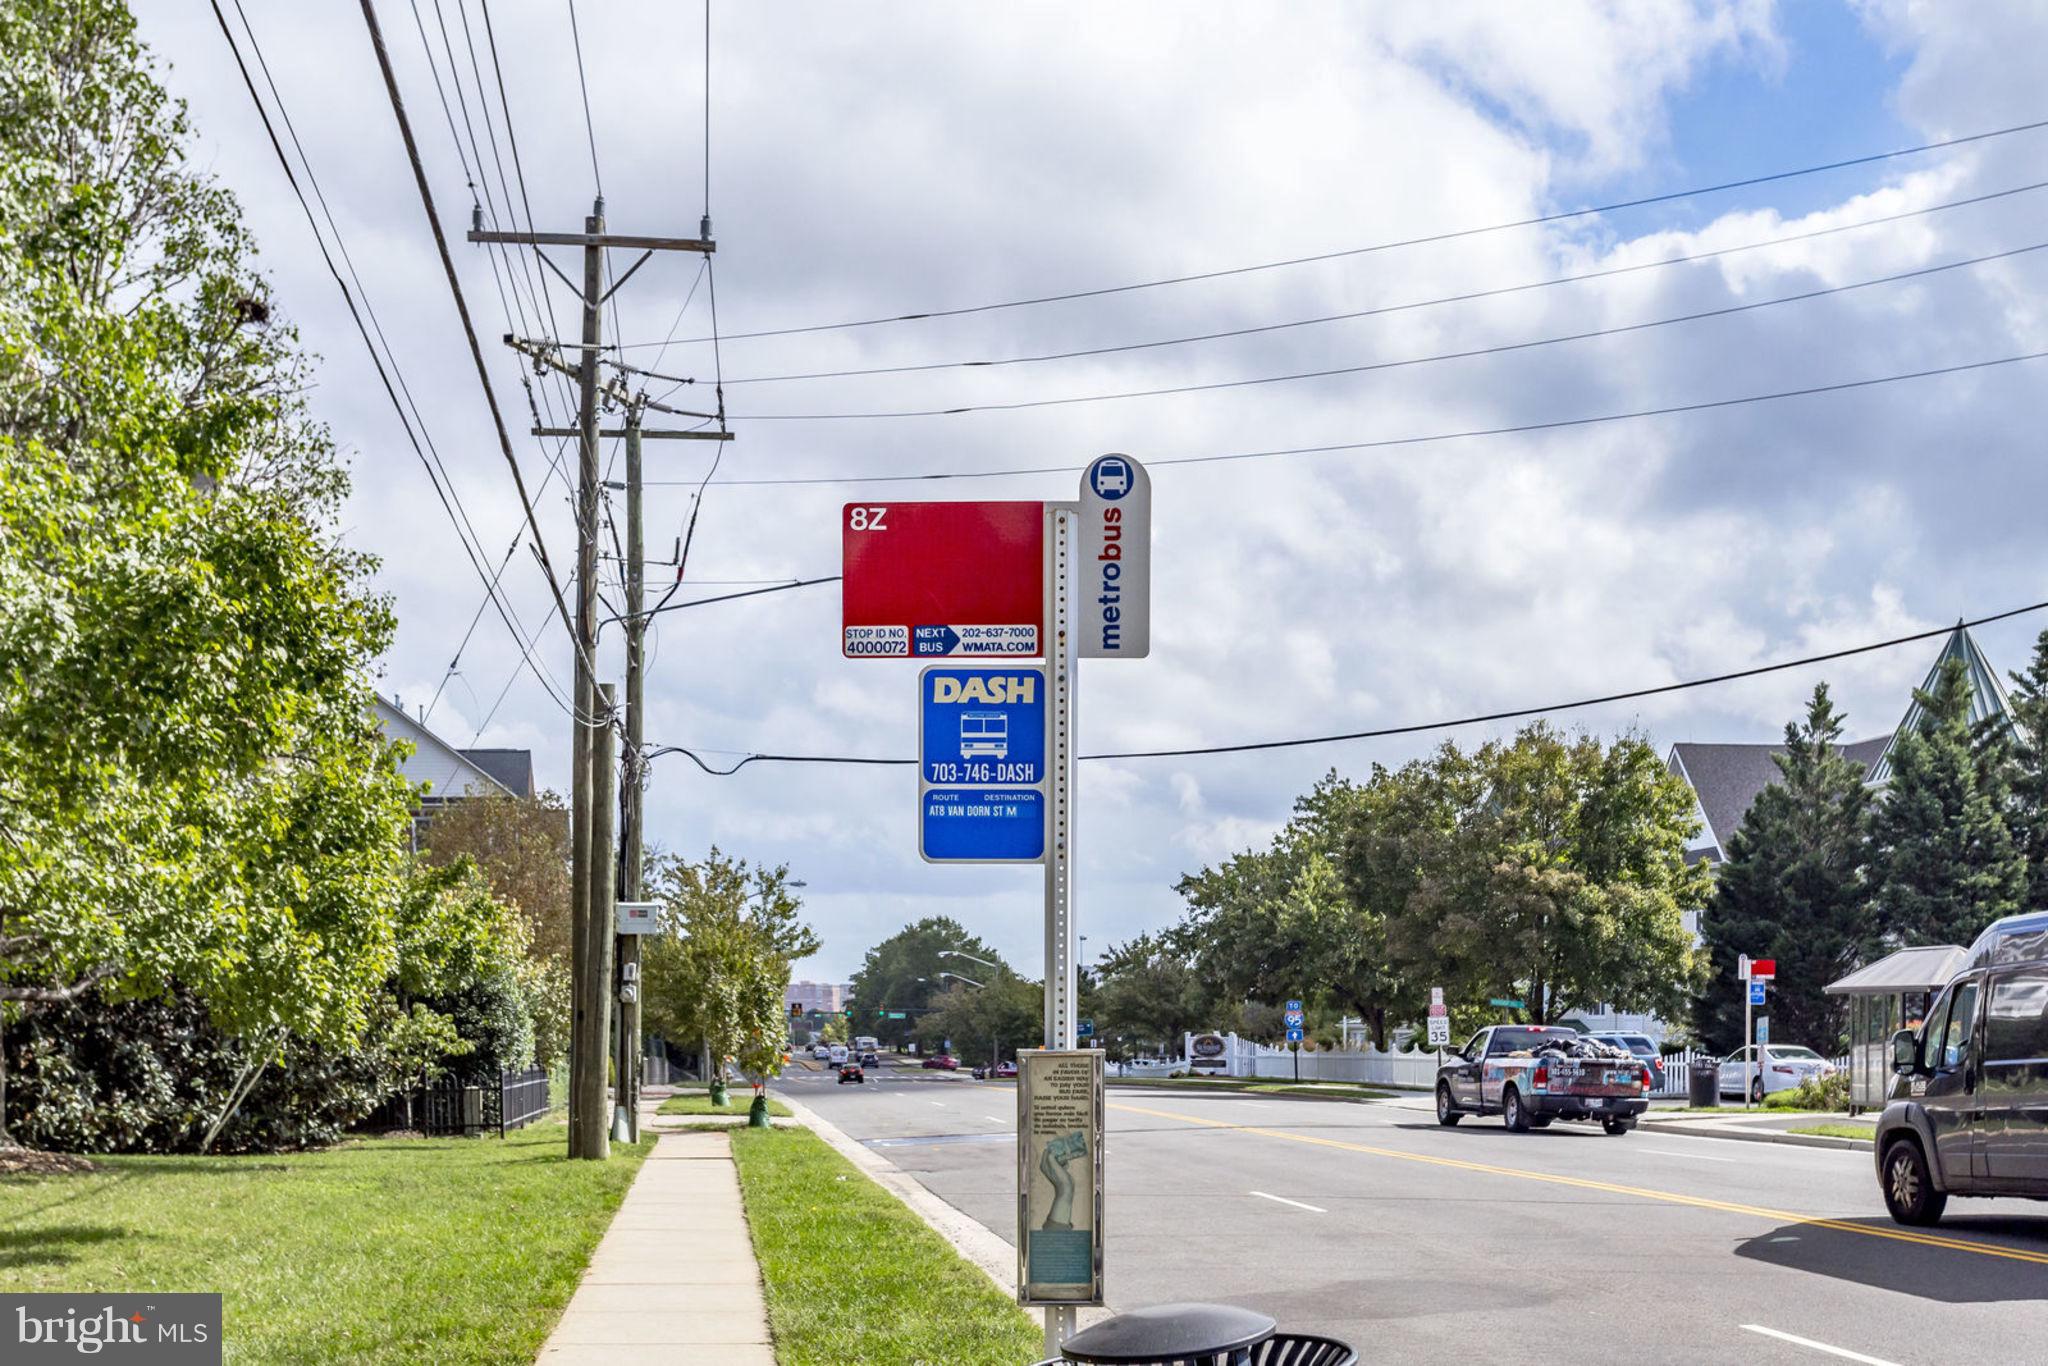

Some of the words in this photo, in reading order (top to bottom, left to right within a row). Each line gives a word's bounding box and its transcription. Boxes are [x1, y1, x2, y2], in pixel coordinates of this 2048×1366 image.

[850, 507, 888, 531] 8Z
[1098, 507, 1122, 650] metrobus
[845, 628, 876, 639] STOP
[877, 628, 887, 639] ID
[889, 628, 907, 639] NO.
[915, 628, 947, 638] NEXT
[962, 628, 1035, 638] 202-637-7000
[846, 641, 907, 654] 4000072
[919, 641, 943, 652] BUS
[962, 641, 1035, 652] WMATA.COM
[933, 677, 1035, 704] DASH
[931, 763, 1034, 782] 703-746-DASH
[929, 806, 945, 816] AT8
[948, 806, 964, 816] VAN
[967, 806, 990, 816] DORN
[993, 806, 1003, 816] ST
[1287, 1015, 1302, 1026] 95
[1431, 1032, 1448, 1042] 35
